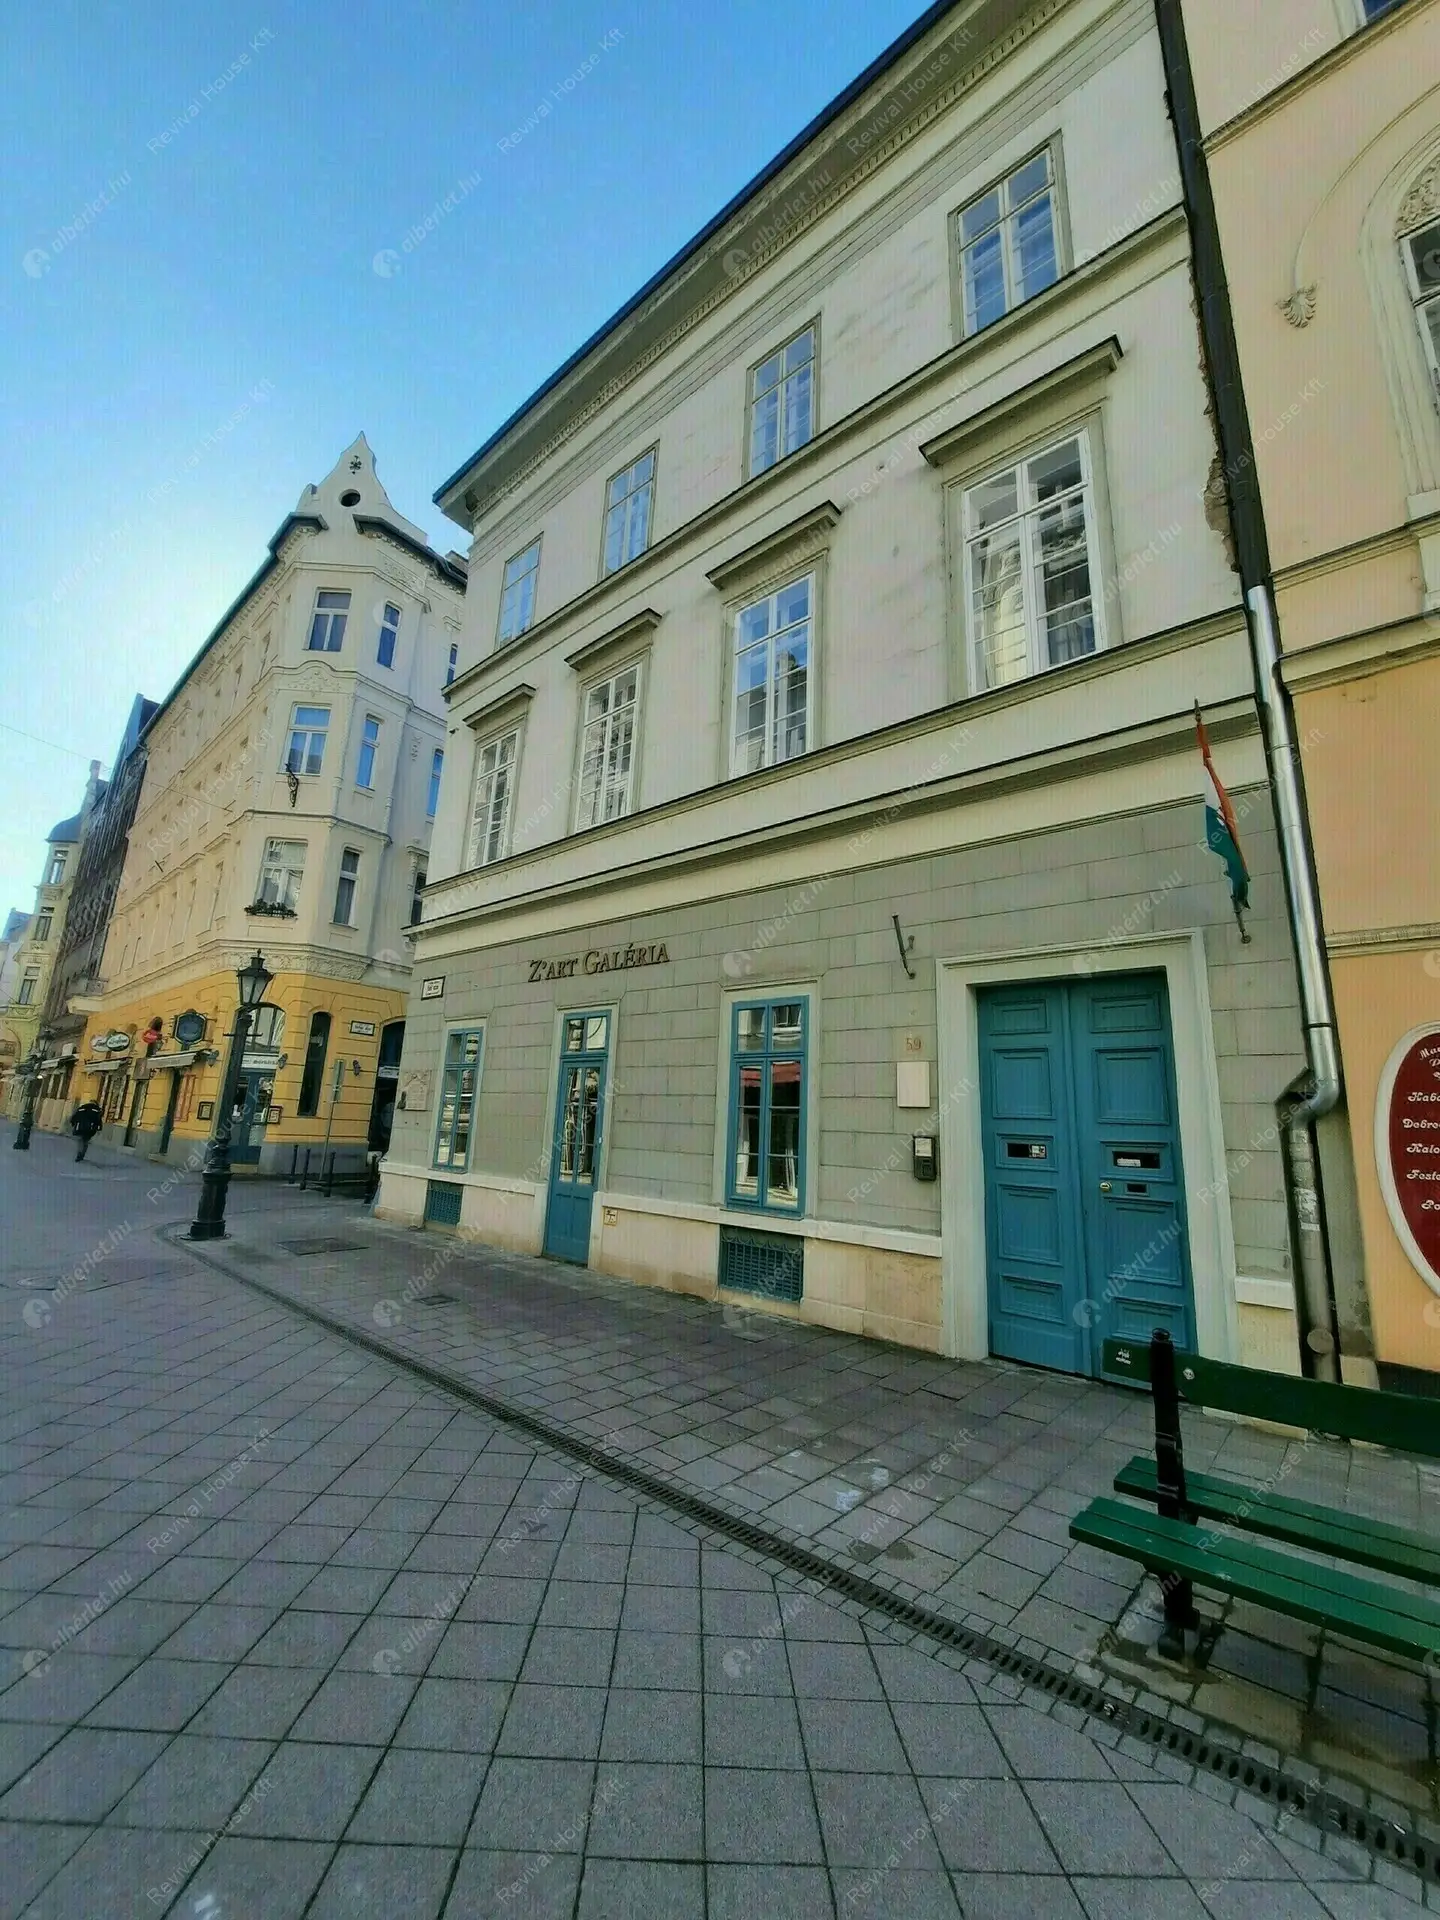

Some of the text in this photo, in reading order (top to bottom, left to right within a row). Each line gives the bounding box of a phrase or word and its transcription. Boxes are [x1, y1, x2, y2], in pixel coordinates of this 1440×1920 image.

[584, 943, 670, 975] GALÉRIA
[905, 1037, 921, 1051] 59
[1403, 1118, 1440, 1129] Debre
